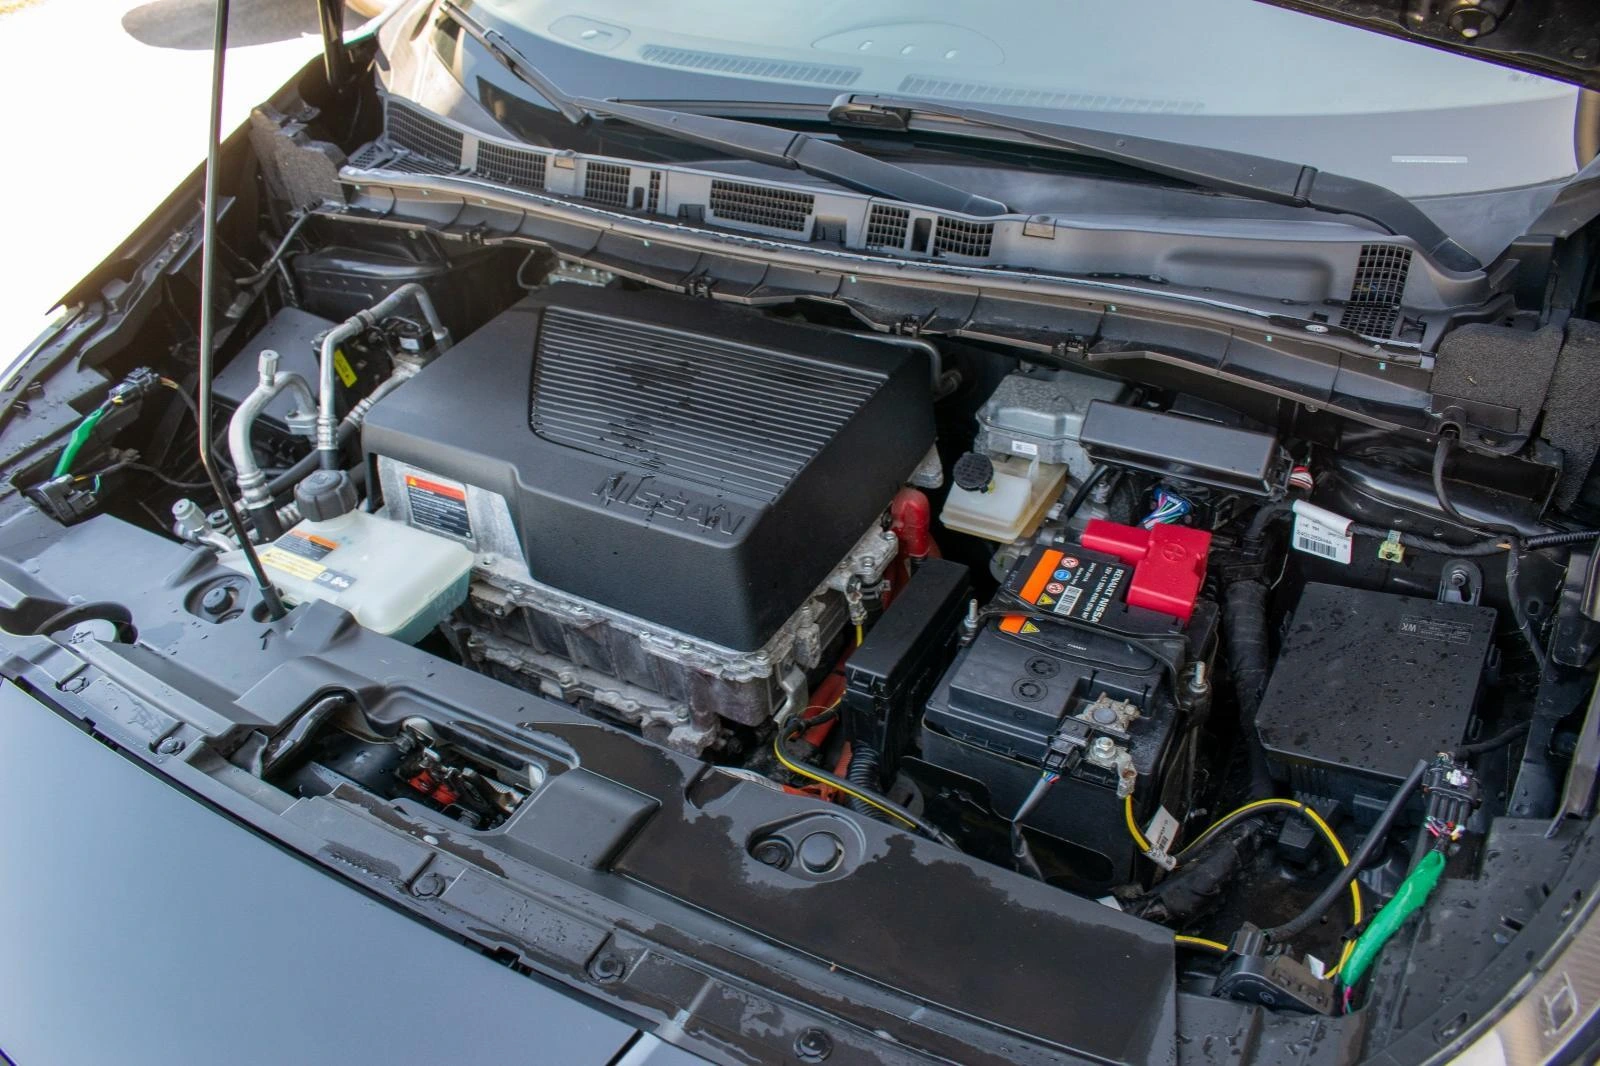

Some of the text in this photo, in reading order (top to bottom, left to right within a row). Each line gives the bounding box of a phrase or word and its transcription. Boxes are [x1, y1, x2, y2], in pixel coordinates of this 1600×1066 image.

[591, 472, 746, 535] NISSAN
[1090, 568, 1125, 623] RENAULT NISSA
